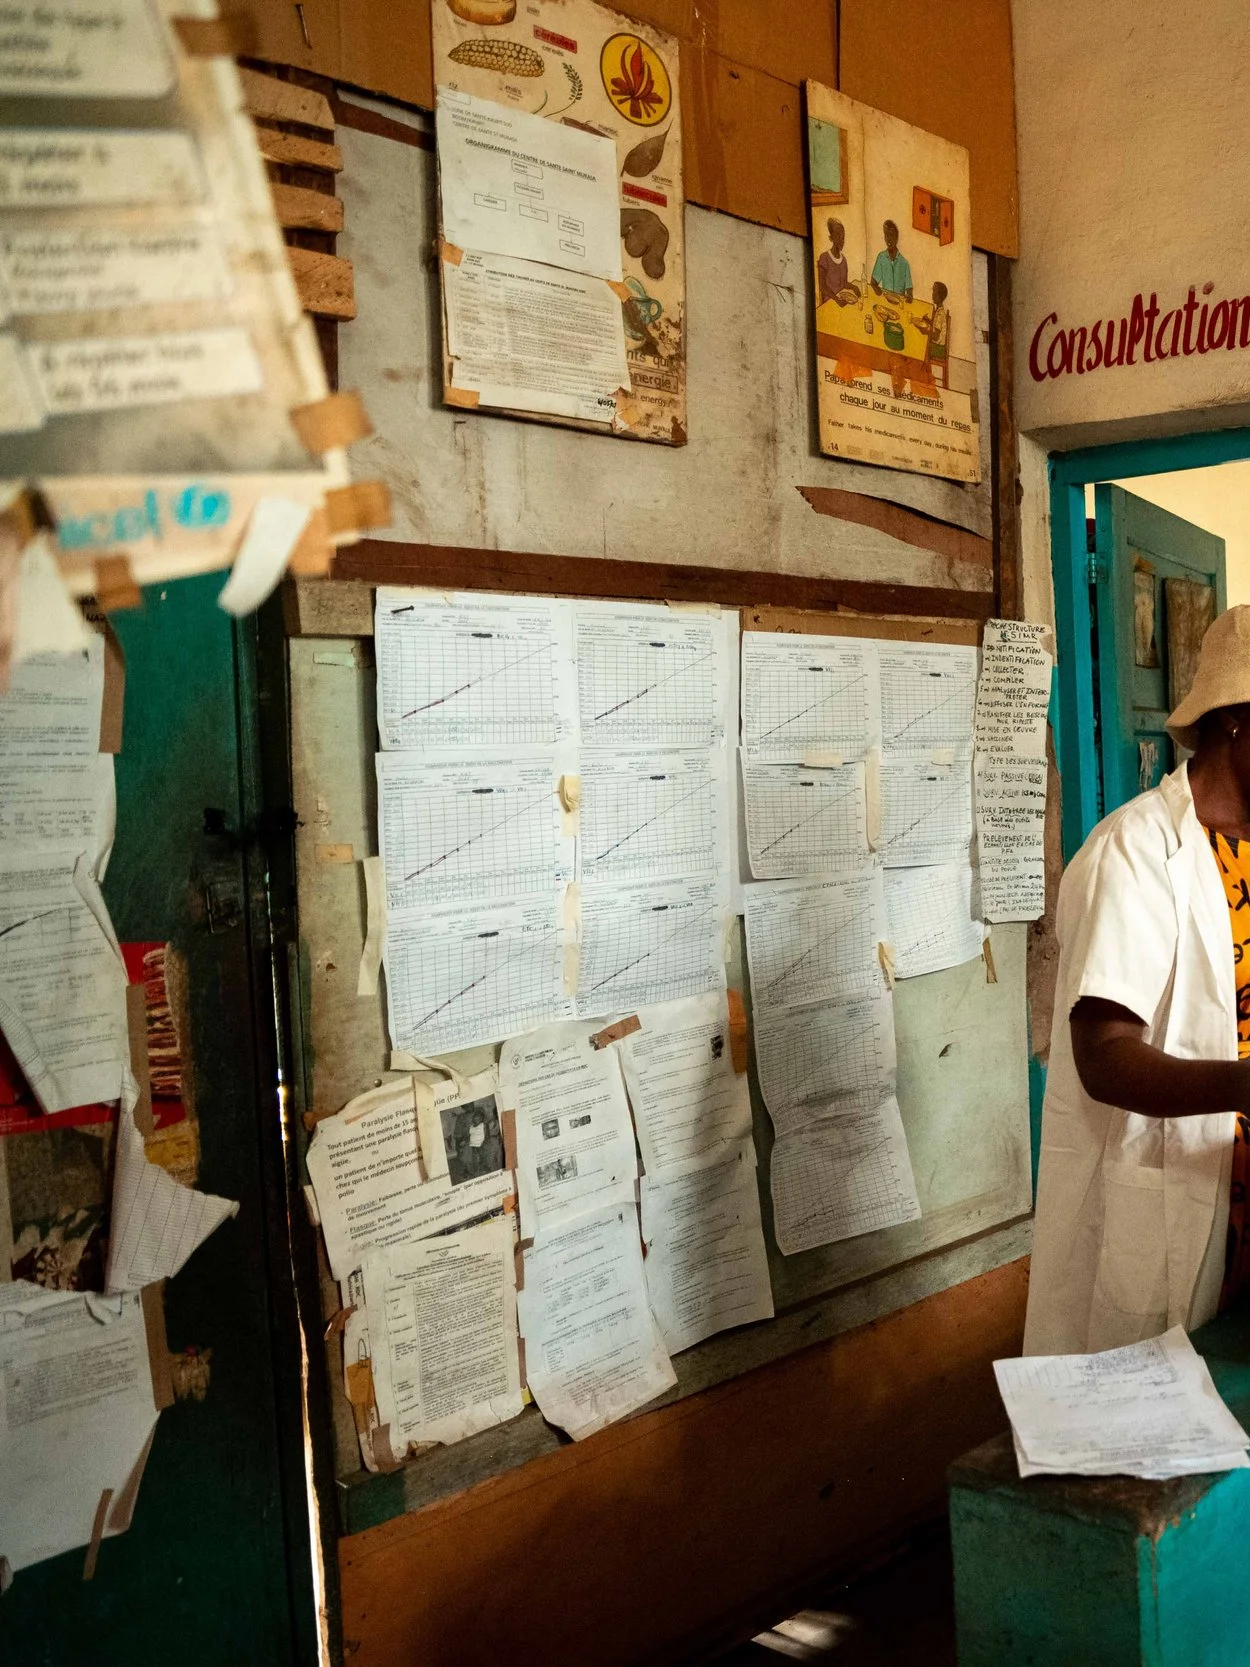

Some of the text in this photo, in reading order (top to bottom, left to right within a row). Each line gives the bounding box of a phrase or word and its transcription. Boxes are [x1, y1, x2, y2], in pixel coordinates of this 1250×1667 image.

[877, 386, 890, 395] ses
[840, 394, 868, 406] chaque
[872, 399, 886, 410] jour
[891, 405, 900, 413] au
[903, 409, 933, 422] moment
[938, 415, 947, 425] du
[343, 1135, 365, 1147] patient
[344, 1167, 366, 1179] patient
